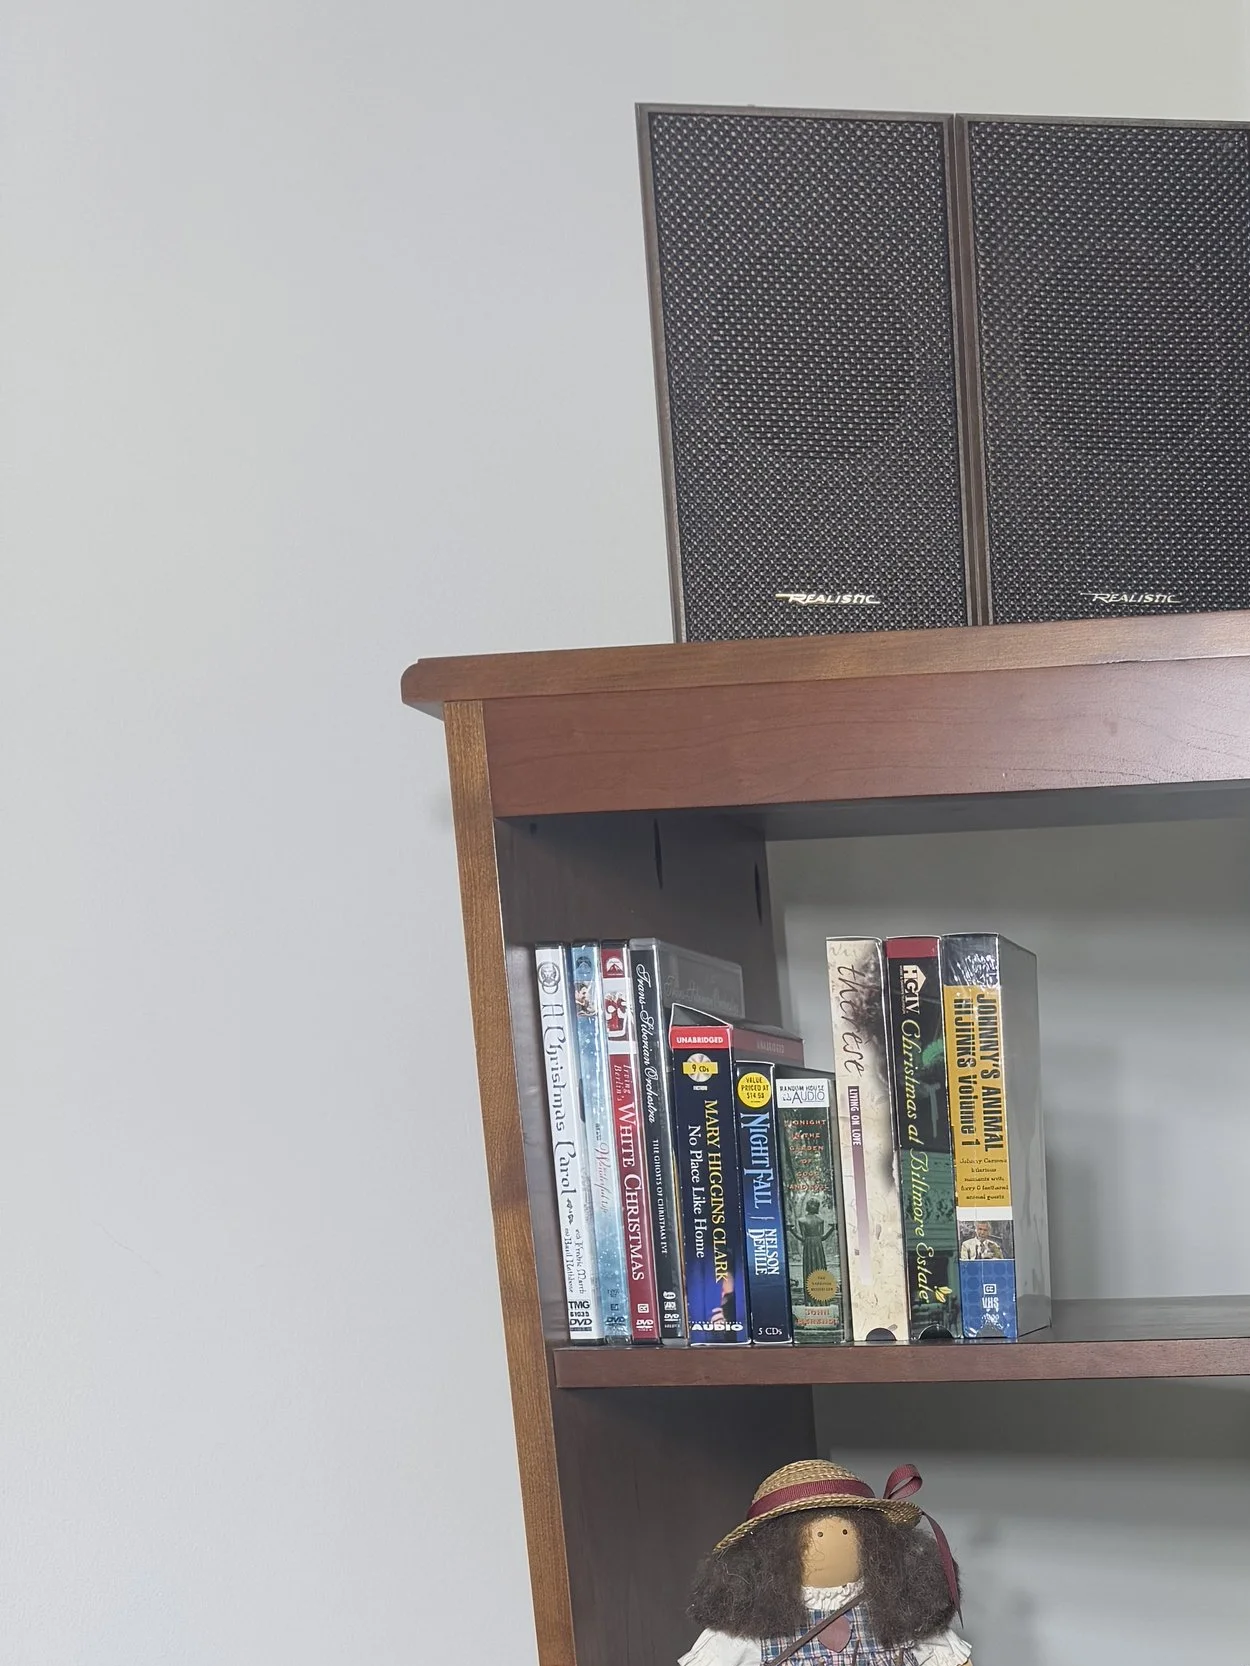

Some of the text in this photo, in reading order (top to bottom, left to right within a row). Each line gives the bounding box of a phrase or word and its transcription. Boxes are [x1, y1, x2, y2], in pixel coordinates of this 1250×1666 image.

[776, 593, 881, 605] REALISTIC
[1080, 591, 1184, 604] REALISTIC
[903, 965, 922, 1014] HGTV
[634, 963, 654, 1068] Trans-Siberian
[676, 1036, 724, 1044] UNABRIDGED
[976, 993, 1000, 1080] JOHNNY'S
[613, 1064, 624, 1101] Berlin's
[622, 1064, 632, 1095] Irving
[691, 1063, 698, 1072] 9
[745, 1076, 763, 1084] VALUE
[541, 1003, 577, 1196] A Christmas Carol
[741, 1083, 770, 1091] PRICED AT
[792, 1091, 825, 1104] AUDIO
[849, 1088, 861, 1146] LIVING ON LOVE
[958, 1074, 978, 1135] Volume
[981, 1085, 1004, 1152] ANIMAL
[652, 1139, 660, 1154] THE
[901, 1019, 935, 1303] Christmas at Biltmore Estate
[653, 1155, 662, 1184] GHOSTS
[617, 1102, 645, 1281] WHITE CHRISTMAS
[688, 1124, 708, 1258] No Place Like Home
[704, 1099, 729, 1284] MARY HIGGINS CLARK
[656, 1198, 667, 1241] CHRISTMAS
[746, 1228, 768, 1276] DEMILLE
[765, 1228, 780, 1275] NELSON
[568, 1301, 590, 1309] TMG
[981, 1297, 999, 1309] VHS
[569, 1318, 592, 1326] DVD
[691, 1323, 744, 1331] AUDIO
[757, 1327, 783, 1335] 5 CDs
